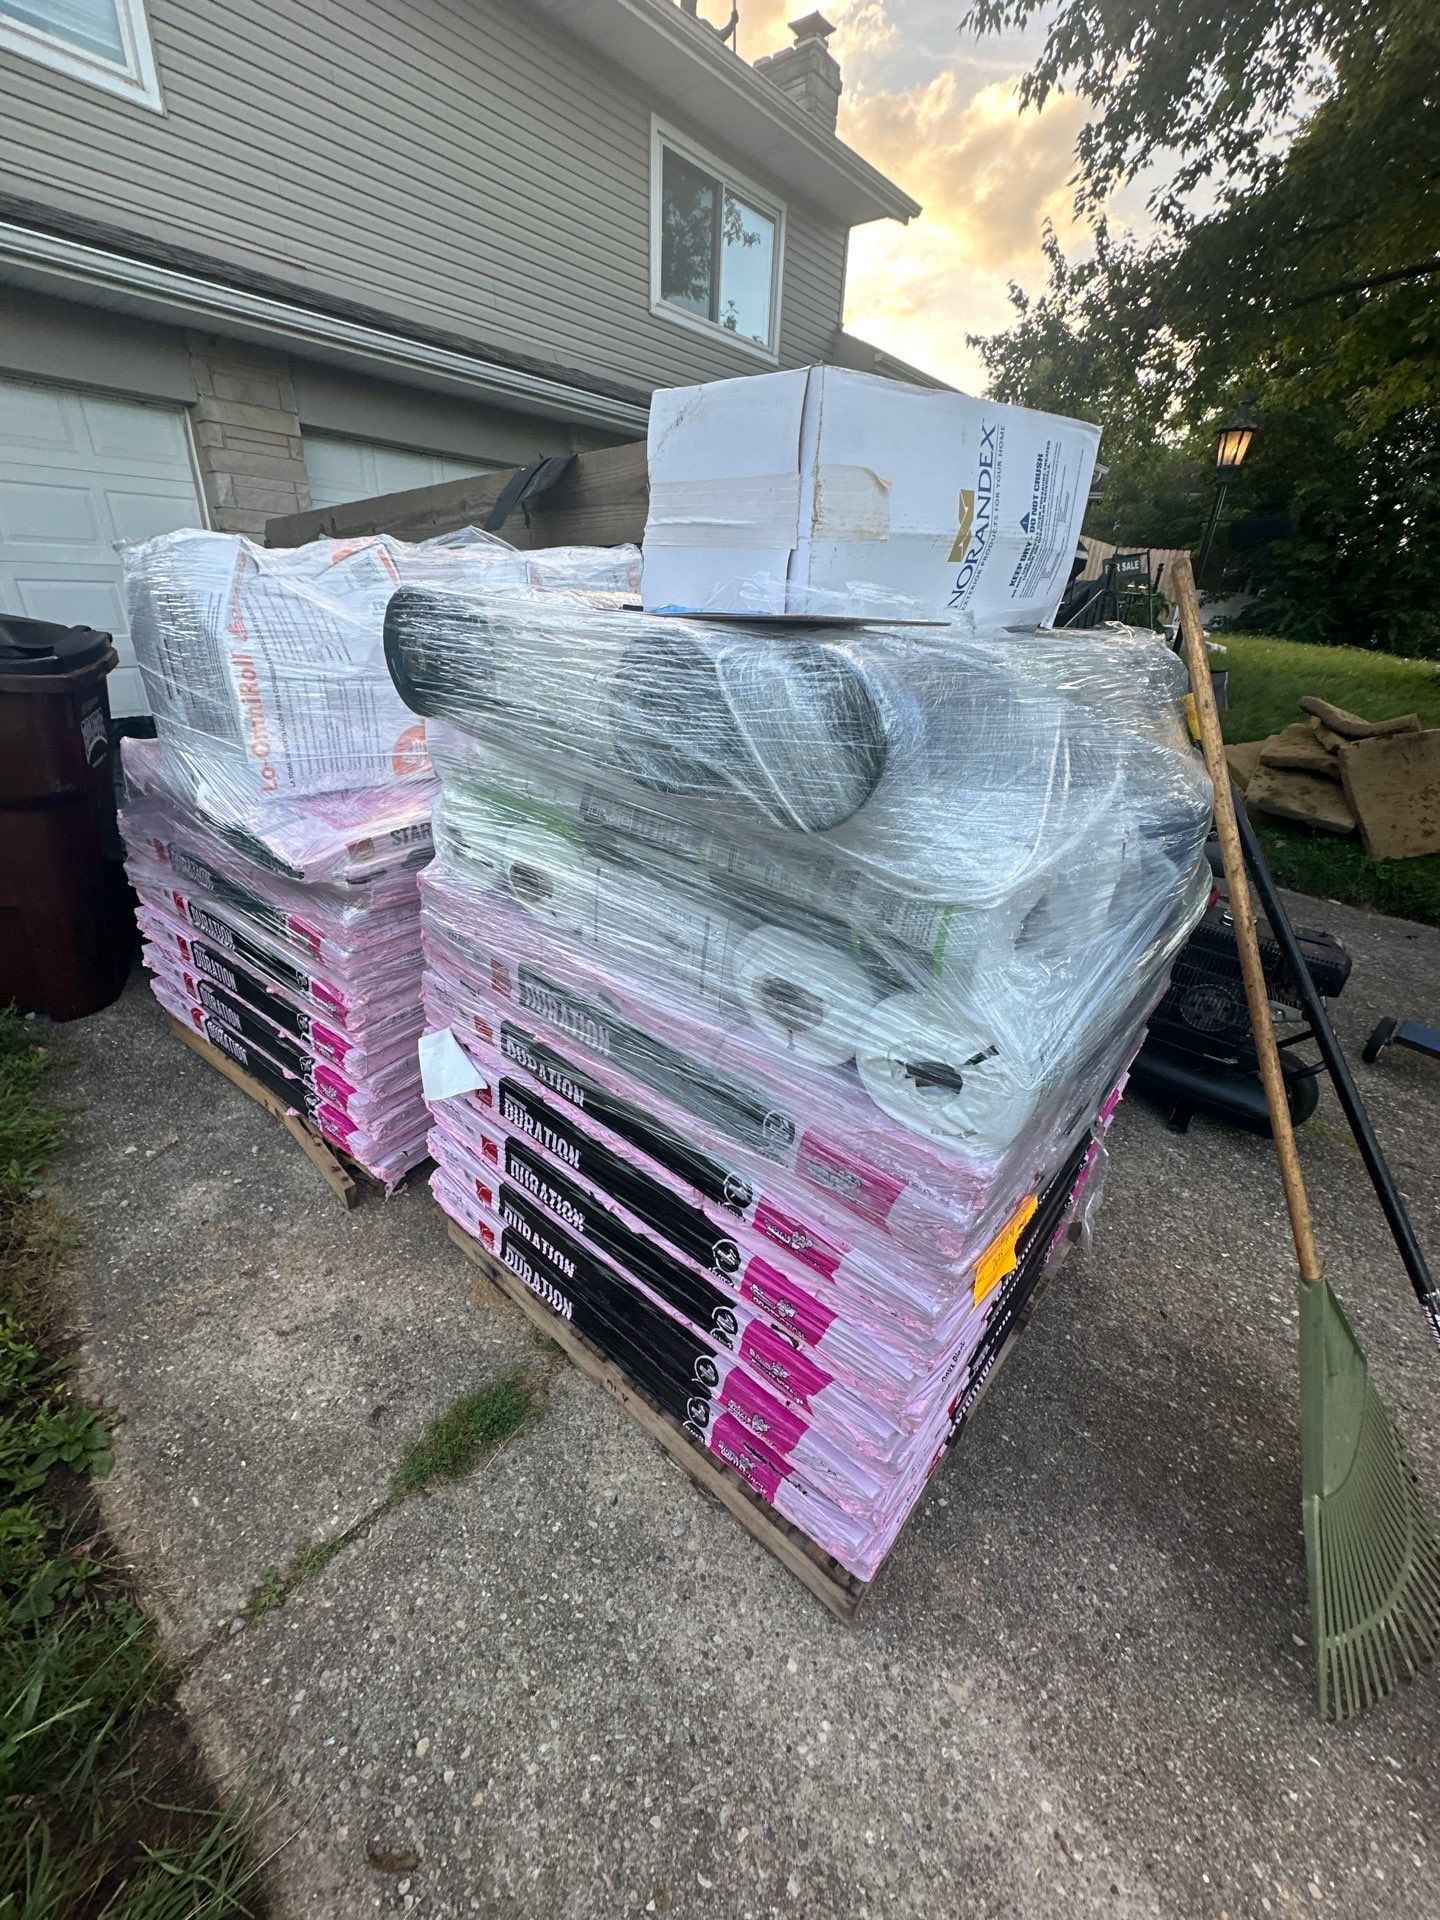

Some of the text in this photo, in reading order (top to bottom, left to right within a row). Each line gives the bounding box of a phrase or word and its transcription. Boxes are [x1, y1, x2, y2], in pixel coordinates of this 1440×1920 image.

[948, 425, 996, 609] NORANDEX
[961, 568, 982, 611] EXTERIOR
[980, 514, 999, 567] PRODUCTS
[993, 492, 1001, 513] FOR
[998, 425, 1006, 457] HOME
[1009, 453, 1044, 587] KEEP DRY DO NOT CRUSH
[1105, 560, 1140, 575] FR SALE
[506, 1037, 585, 1107] DURATION
[504, 1098, 580, 1169] DURATION
[510, 1159, 585, 1232] DURATION
[505, 1246, 573, 1320] DURATION
